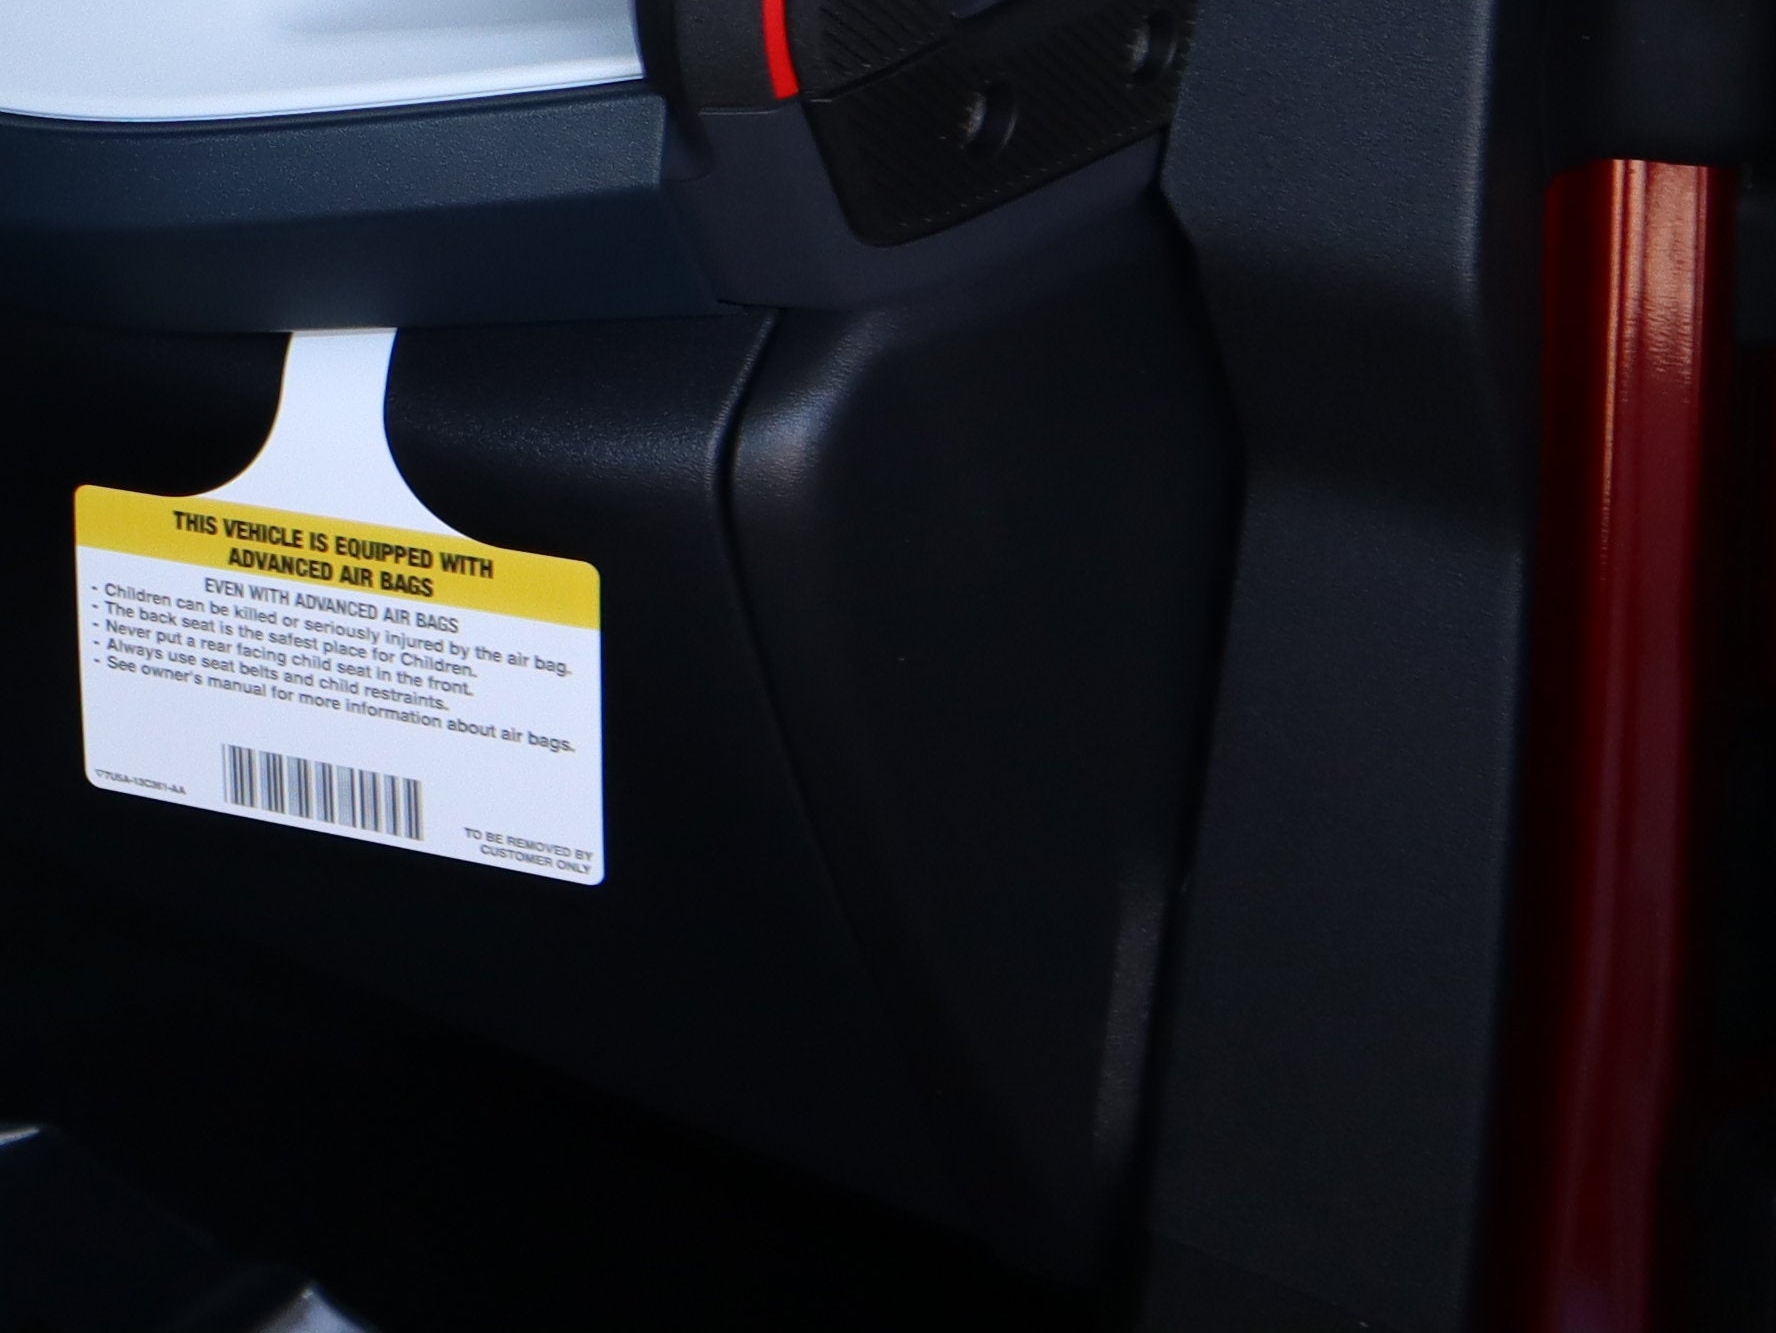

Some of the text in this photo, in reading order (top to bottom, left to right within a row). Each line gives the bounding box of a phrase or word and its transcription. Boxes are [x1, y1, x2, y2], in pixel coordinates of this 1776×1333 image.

[173, 510, 494, 579] THIS VEHICLE IS EQUIPPED WITH
[228, 547, 434, 598] ADVANCED AIR BAGS
[103, 600, 477, 678] The back seat is the safest place for Children.
[104, 582, 571, 677] Children can be killed or seriously injured by the air bag.
[204, 577, 459, 634] EVEN WITH ADVANCED AIR BAGS
[105, 618, 473, 697] Never put a rear facing child seat in the front.
[106, 637, 449, 711] Always use seat belts and child restraints.
[106, 655, 575, 753] See owner's manual for more information about air bags.
[463, 826, 593, 861] TO BE REMOVED BY
[479, 844, 591, 875] CUSTOMER ONLY
